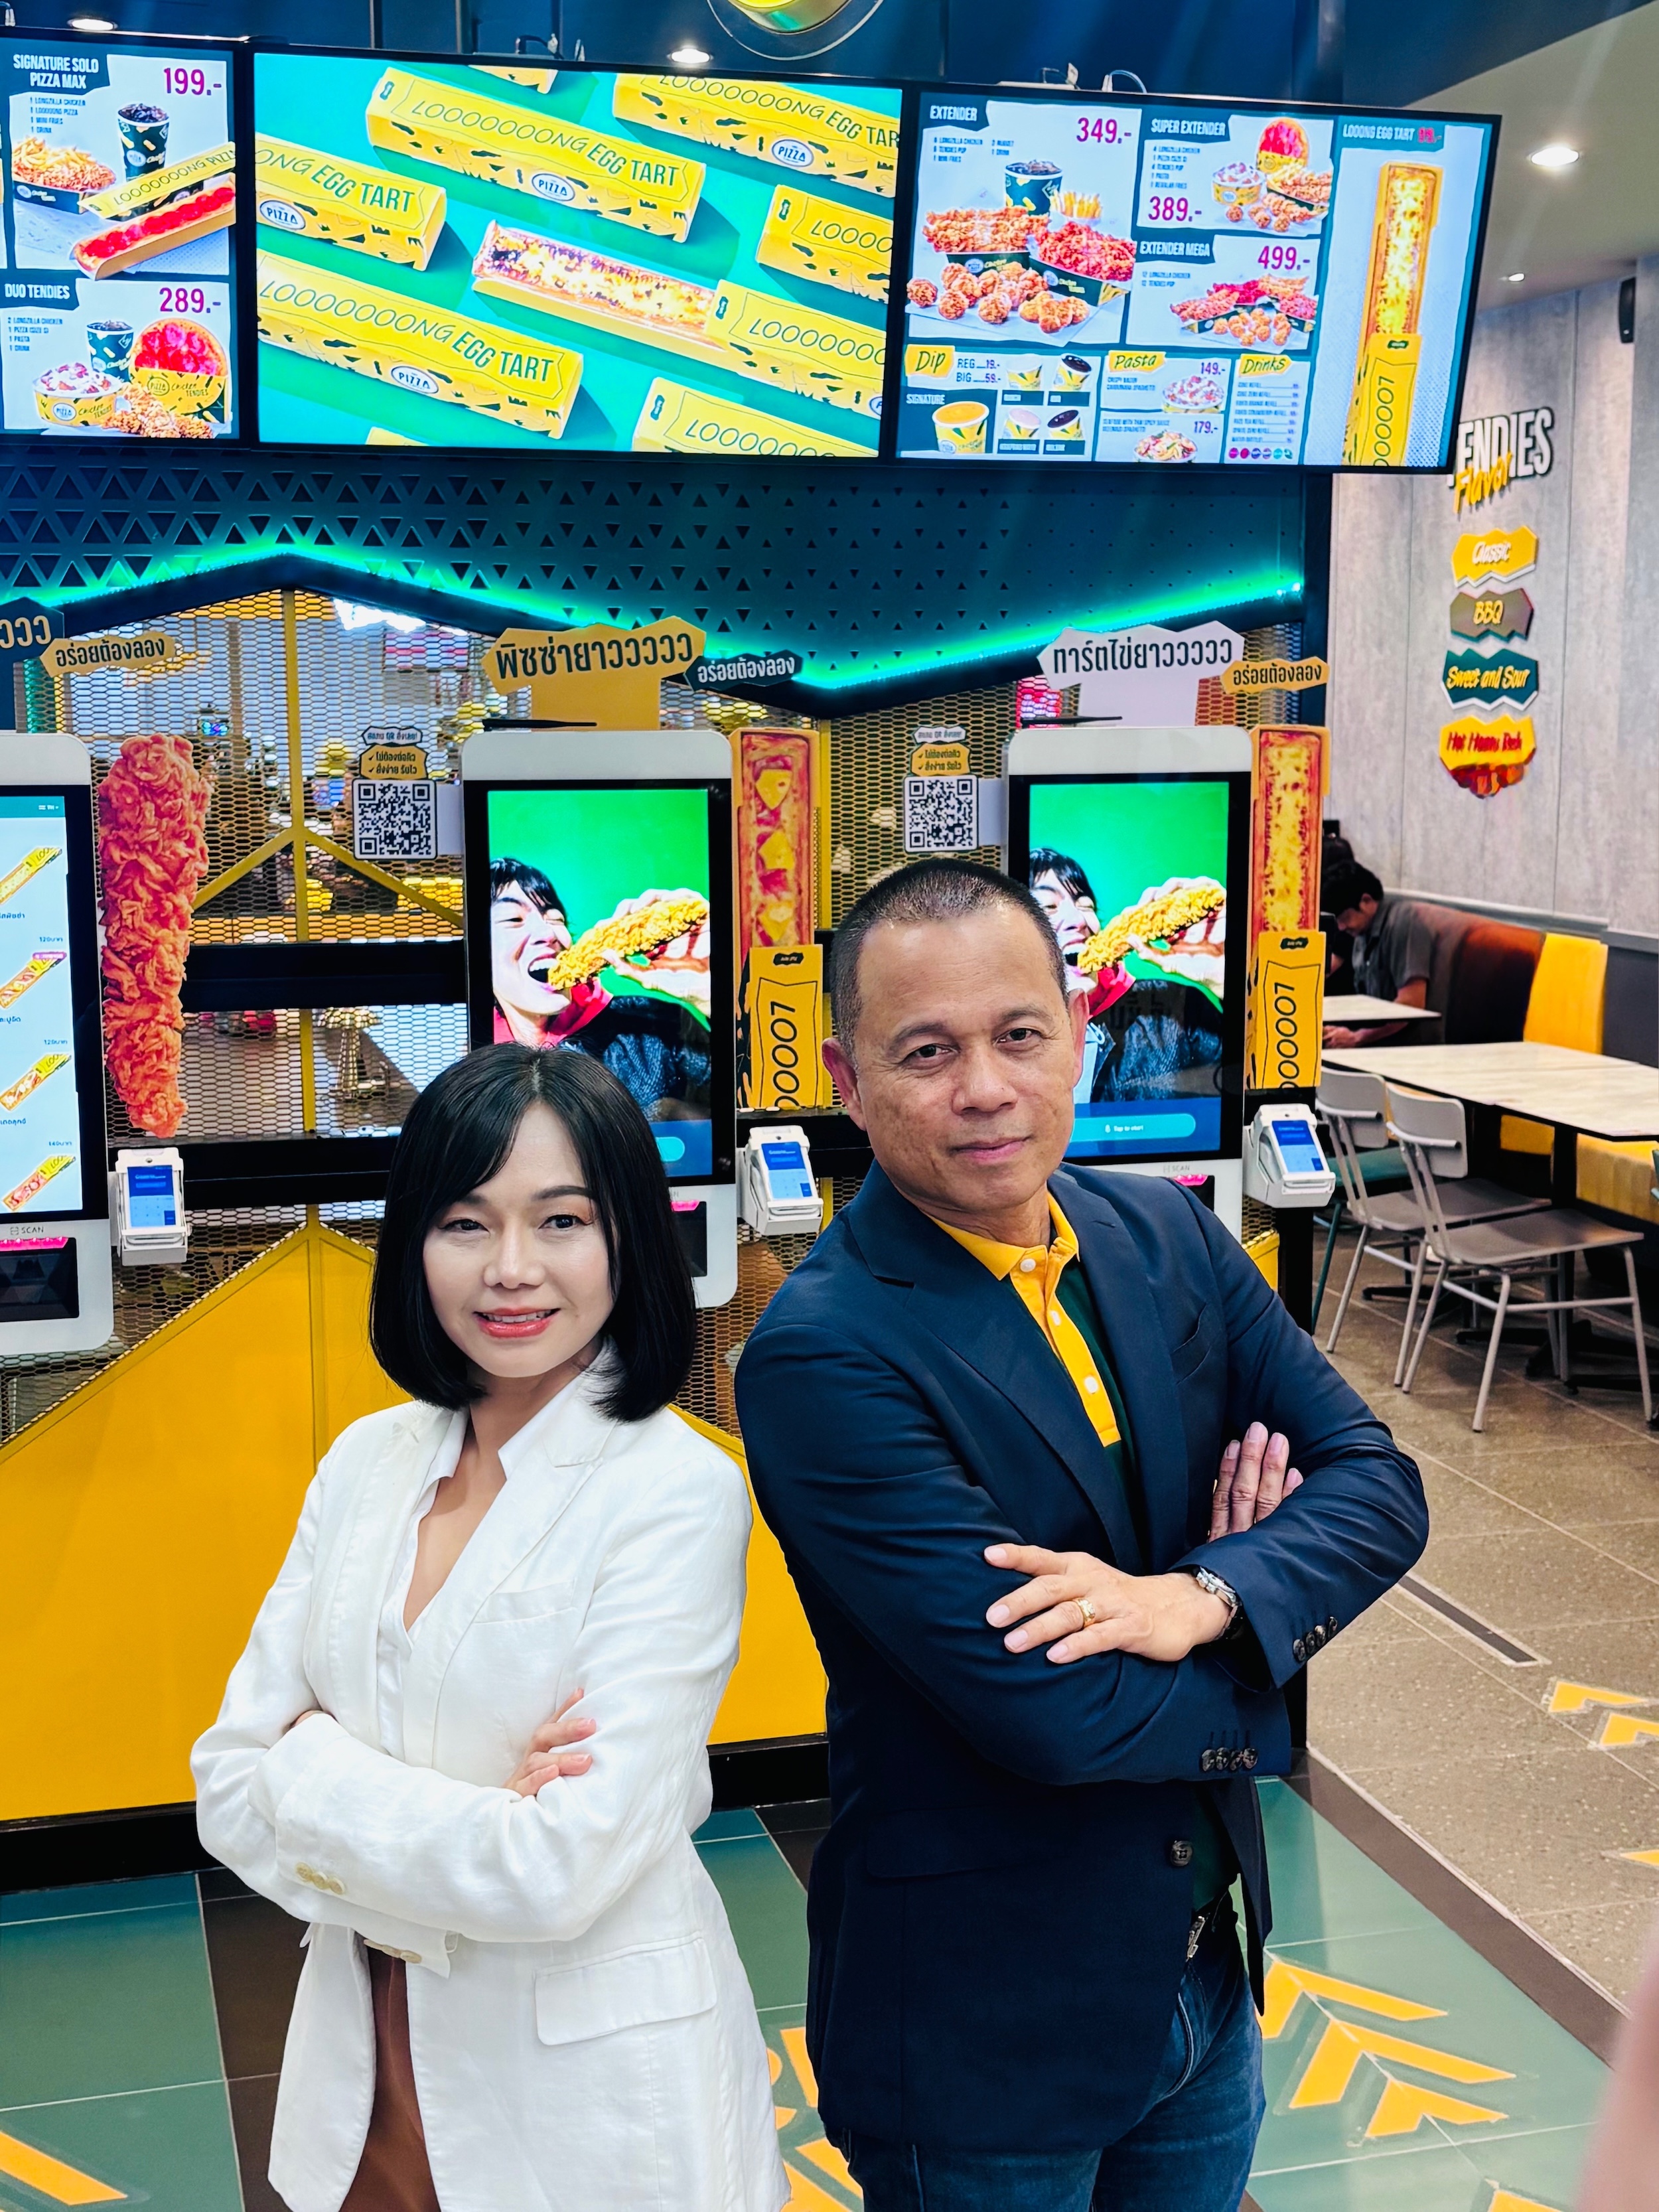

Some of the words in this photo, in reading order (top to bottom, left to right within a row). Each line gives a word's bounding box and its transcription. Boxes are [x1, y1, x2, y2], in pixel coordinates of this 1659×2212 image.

[13, 54, 71, 72] SIGNATURE
[72, 59, 99, 73] SOLO
[30, 72, 61, 88] PIZZA
[62, 75, 86, 89] MAX
[164, 68, 222, 96] 199.-
[930, 105, 977, 121] EXTENDER
[825, 111, 863, 139] EGG
[1076, 117, 1132, 144] 349.-
[1151, 118, 1180, 133] SUPER
[1181, 119, 1226, 136] EXTENDER
[1376, 126, 1393, 140] EGG
[1394, 127, 1415, 141] TART
[778, 145, 805, 161] PIZZA
[587, 143, 626, 175] EGG
[630, 159, 679, 187] TART
[311, 165, 357, 198] EGG
[361, 183, 415, 212] TART
[538, 178, 567, 196] PIZZA
[266, 206, 298, 225] PIZZA
[1148, 196, 1202, 222] 389.-
[1139, 241, 1185, 256] EXTENDER
[1185, 243, 1210, 257] MEGA
[1258, 245, 1310, 271] 499.-
[5, 283, 26, 297] DUO
[27, 284, 70, 299] TENDIES
[159, 287, 221, 313] 289.-
[452, 331, 496, 368] EGG
[499, 350, 554, 382] TART
[915, 350, 946, 374] Dip
[957, 358, 975, 369] REG
[1114, 354, 1157, 368] Pasta
[1242, 357, 1286, 374] Drinks
[398, 371, 431, 390] PIZZA
[956, 372, 972, 382] BIG
[1200, 362, 1225, 376] 149.-
[906, 394, 945, 405] SIGNATURE
[1194, 421, 1218, 434] 179.-
[1455, 406, 1554, 479] ENDIES
[1472, 541, 1511, 564] Classic
[1473, 600, 1504, 624] BBQ
[56, 638, 165, 668] อร่อยต้องลอง
[496, 633, 693, 680] พิซซ่ายาววววว
[1053, 636, 1232, 674] ทาร์ตไข่ยาววววว
[697, 654, 796, 684] อร่อยต้องลอง
[1233, 662, 1323, 686] อร่อยต้องลอง
[1447, 666, 1480, 689] Sweet
[1480, 666, 1504, 689] and
[1502, 666, 1530, 689] Sour
